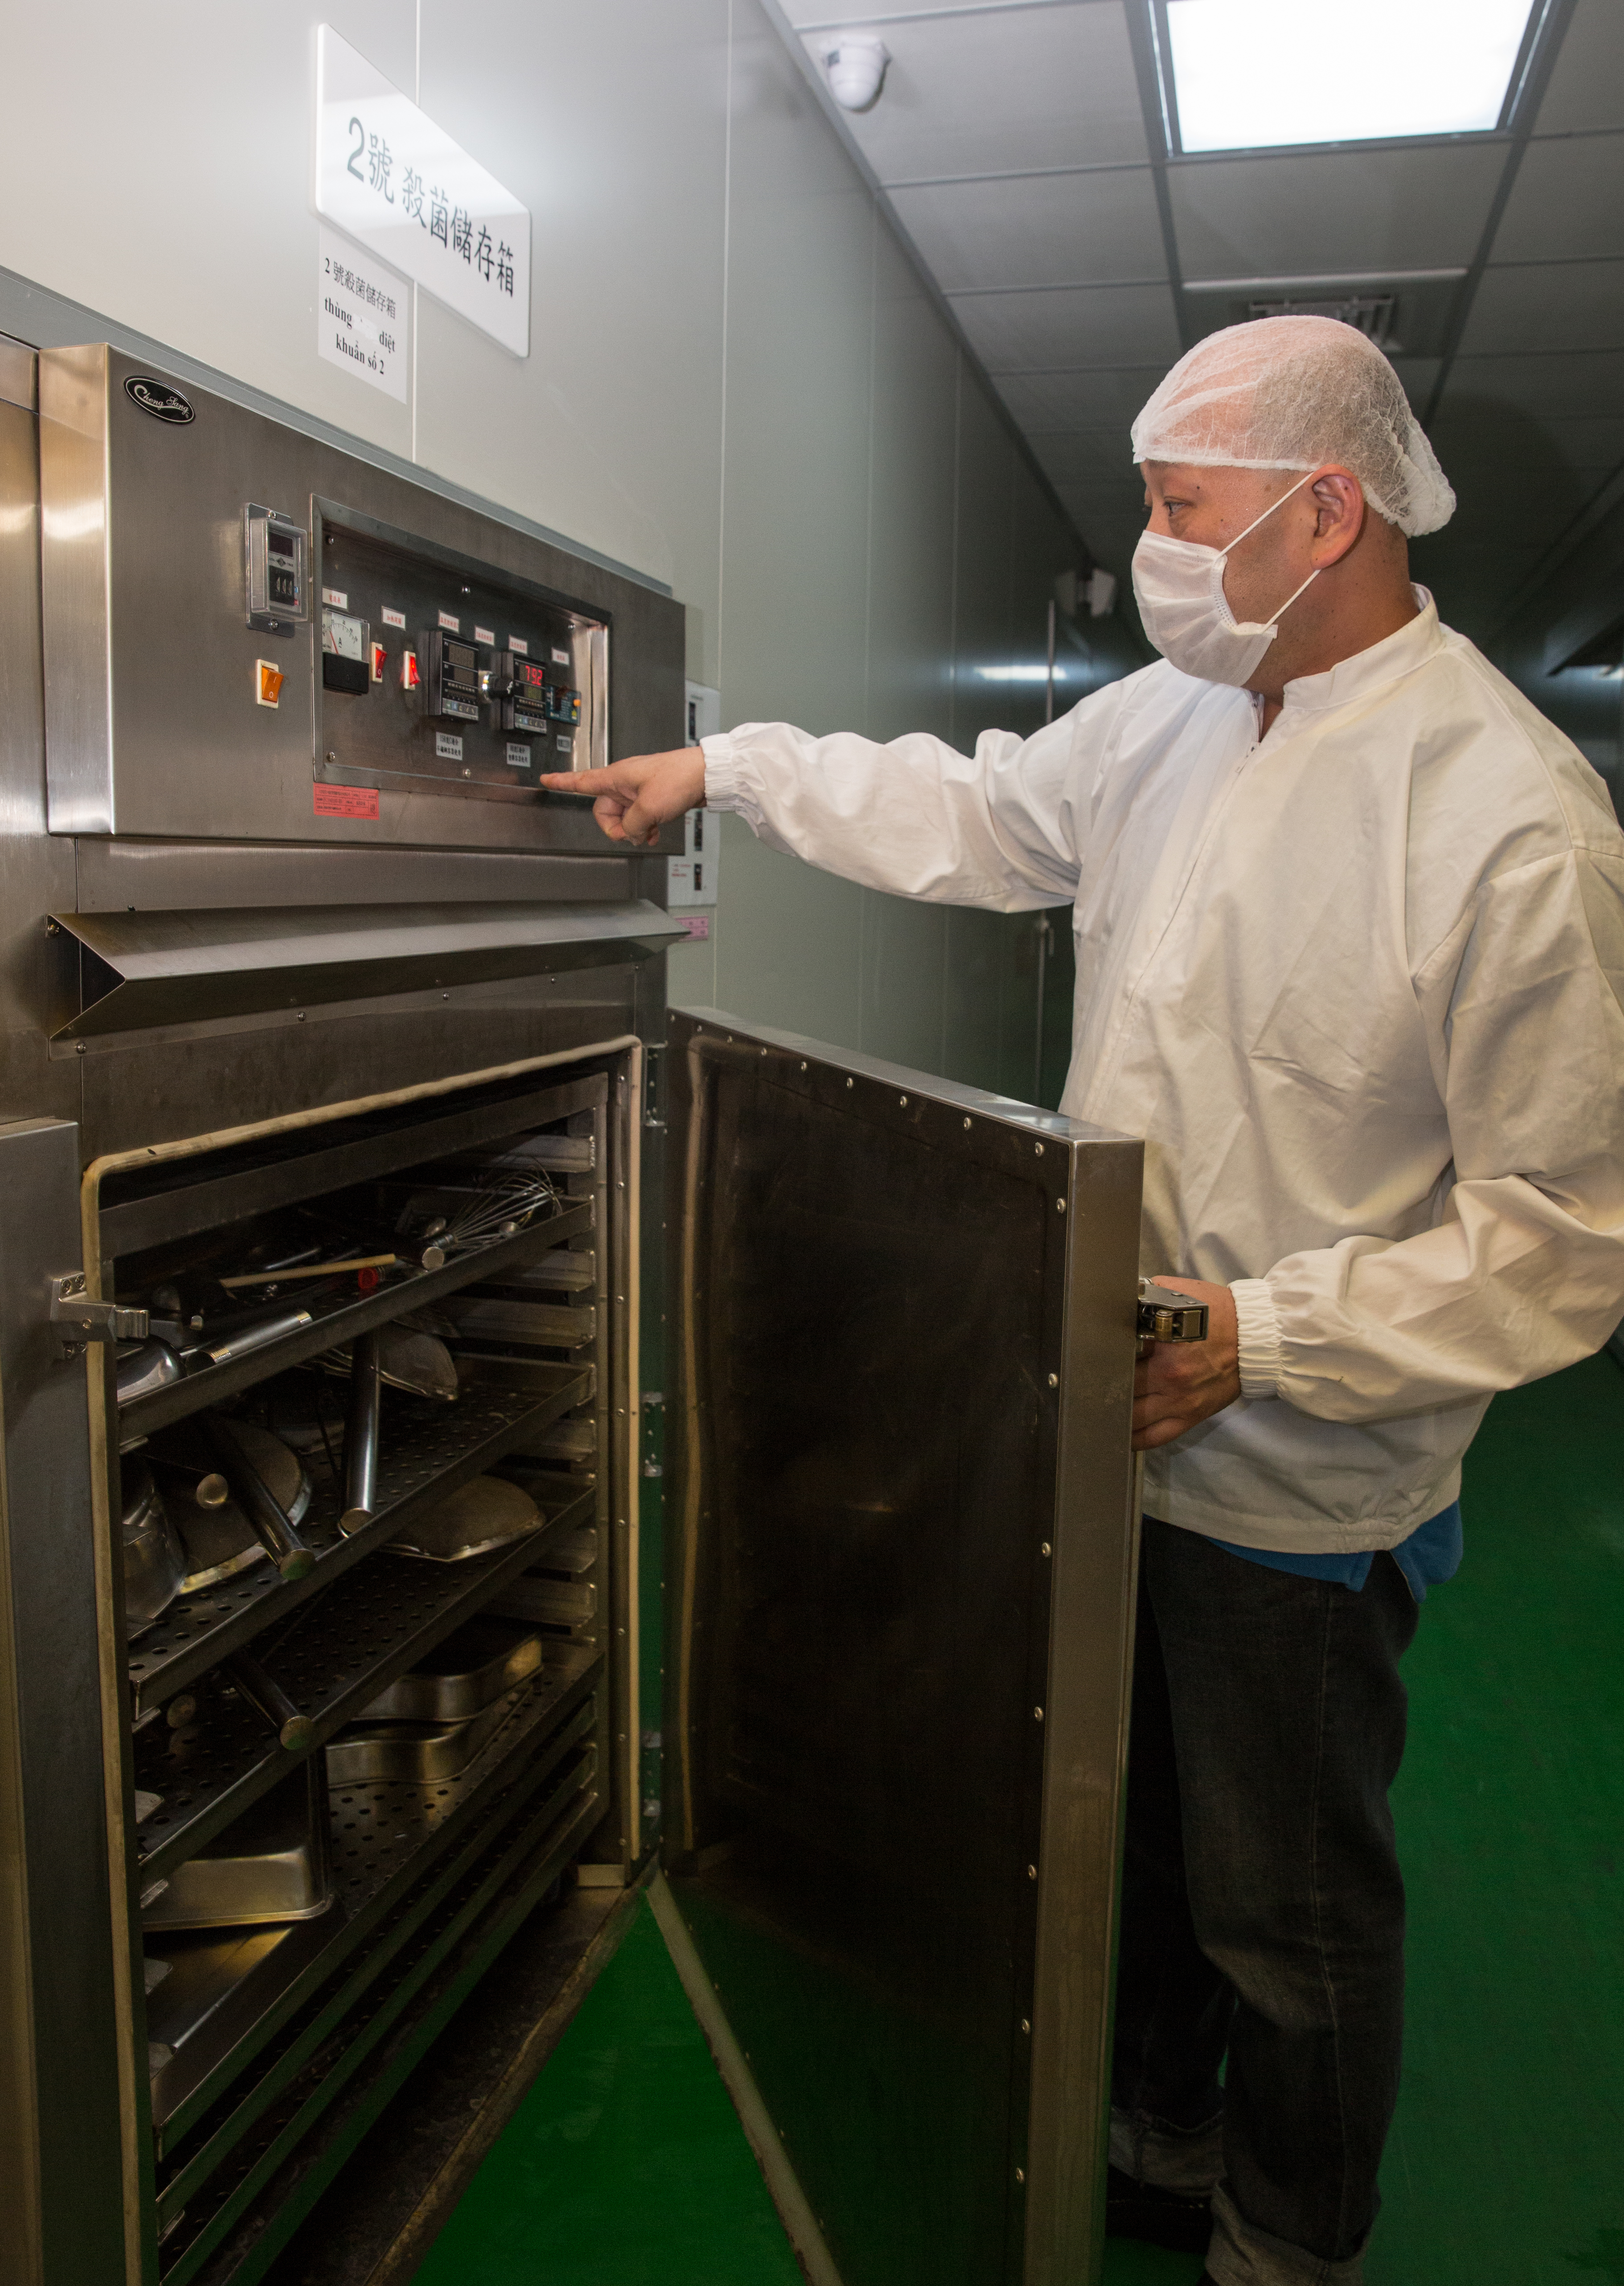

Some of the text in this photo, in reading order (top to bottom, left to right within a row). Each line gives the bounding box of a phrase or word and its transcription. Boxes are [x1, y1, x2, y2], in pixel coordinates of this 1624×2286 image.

[347, 117, 513, 297] 2號 殺菌儲存箱
[325, 258, 330, 274] 2
[324, 297, 395, 354] thùng diệt
[336, 333, 384, 375] khuẩn số 2
[134, 384, 190, 415] Cheng Sang
